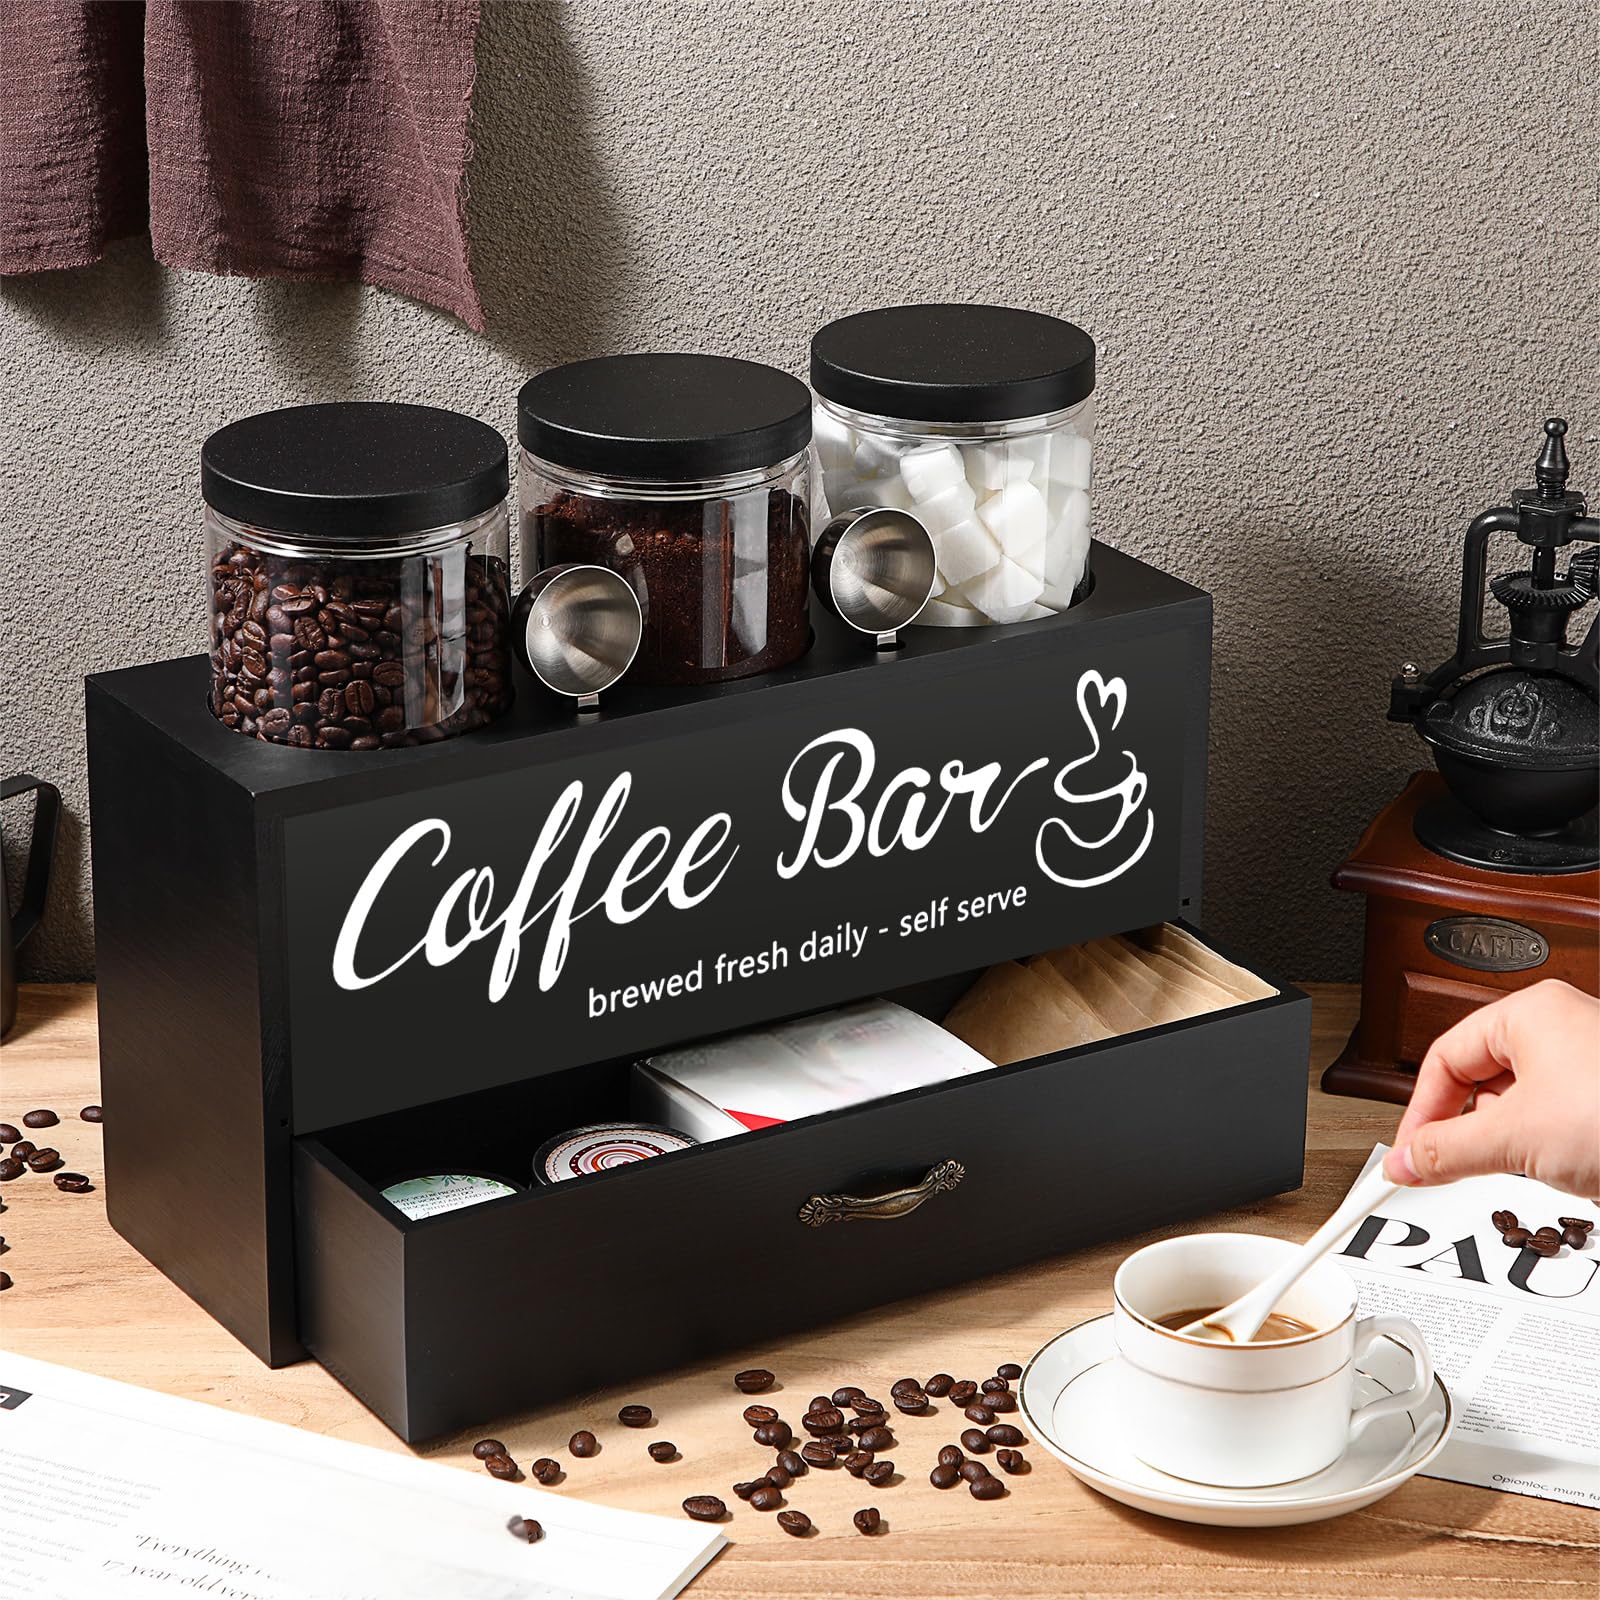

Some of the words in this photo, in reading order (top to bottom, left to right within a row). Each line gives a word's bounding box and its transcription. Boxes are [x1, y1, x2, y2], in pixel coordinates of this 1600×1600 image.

[333, 771, 740, 1003] Coffee
[777, 728, 1049, 879] Bar
[588, 960, 703, 1018] brewed
[714, 941, 789, 985] fresh
[800, 922, 869, 963] daily
[899, 896, 949, 937] self
[957, 886, 1027, 922] serve
[1449, 929, 1526, 960] CAFE
